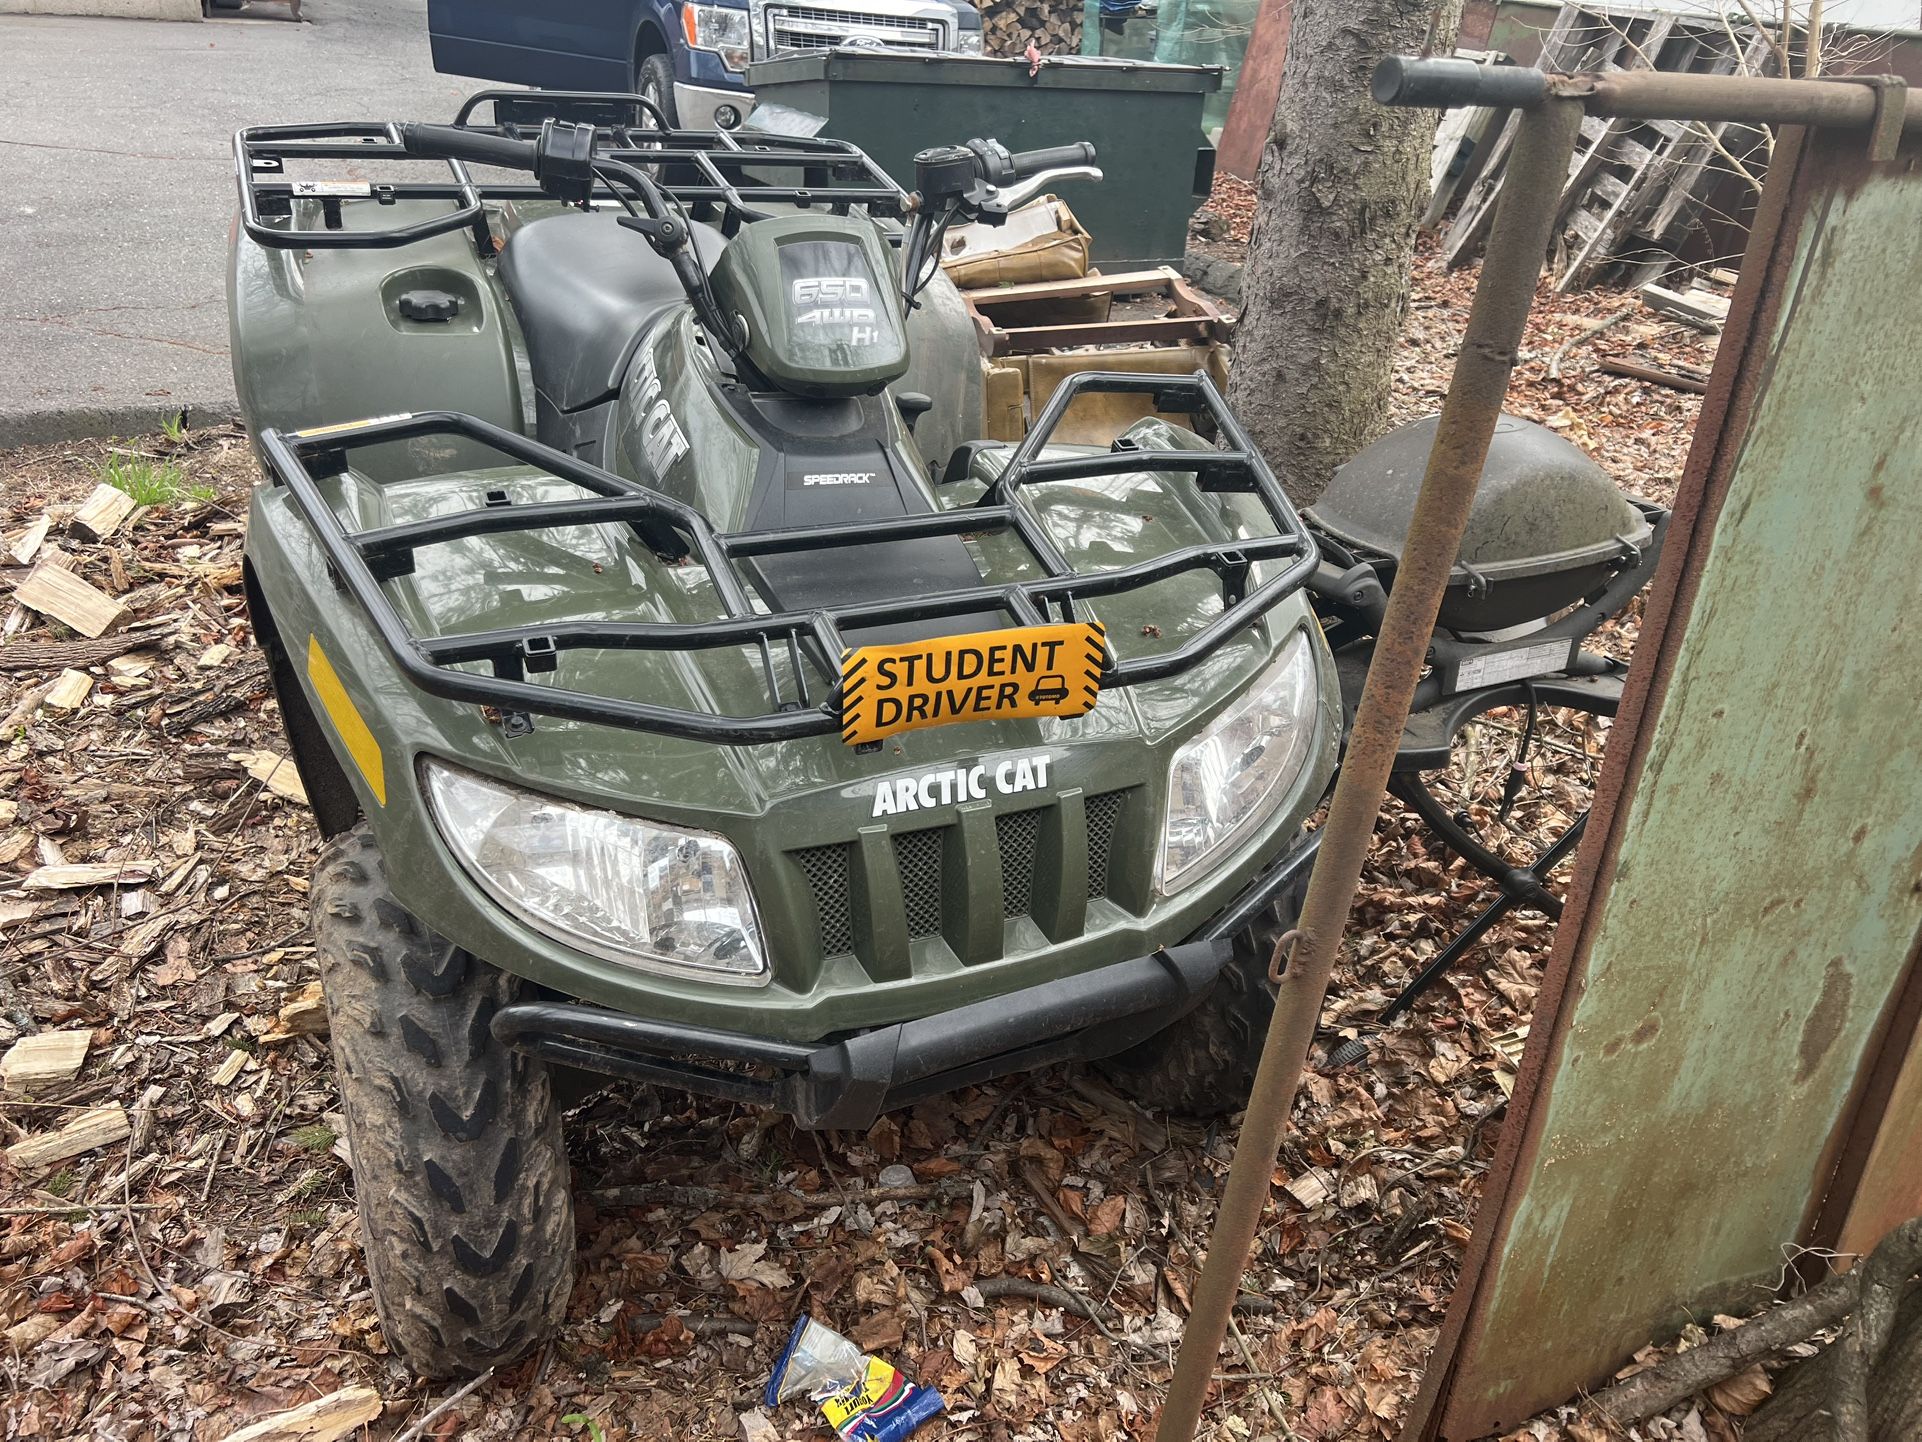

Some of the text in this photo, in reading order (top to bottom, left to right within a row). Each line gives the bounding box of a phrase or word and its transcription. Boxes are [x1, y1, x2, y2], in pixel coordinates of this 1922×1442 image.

[793, 278, 870, 305] 650
[795, 308, 876, 326] 4WD
[641, 399, 690, 483] CAT
[876, 641, 1064, 691] STUDENT
[875, 682, 1020, 728] DRIVER
[872, 754, 1051, 818] ARCTIC CAT
